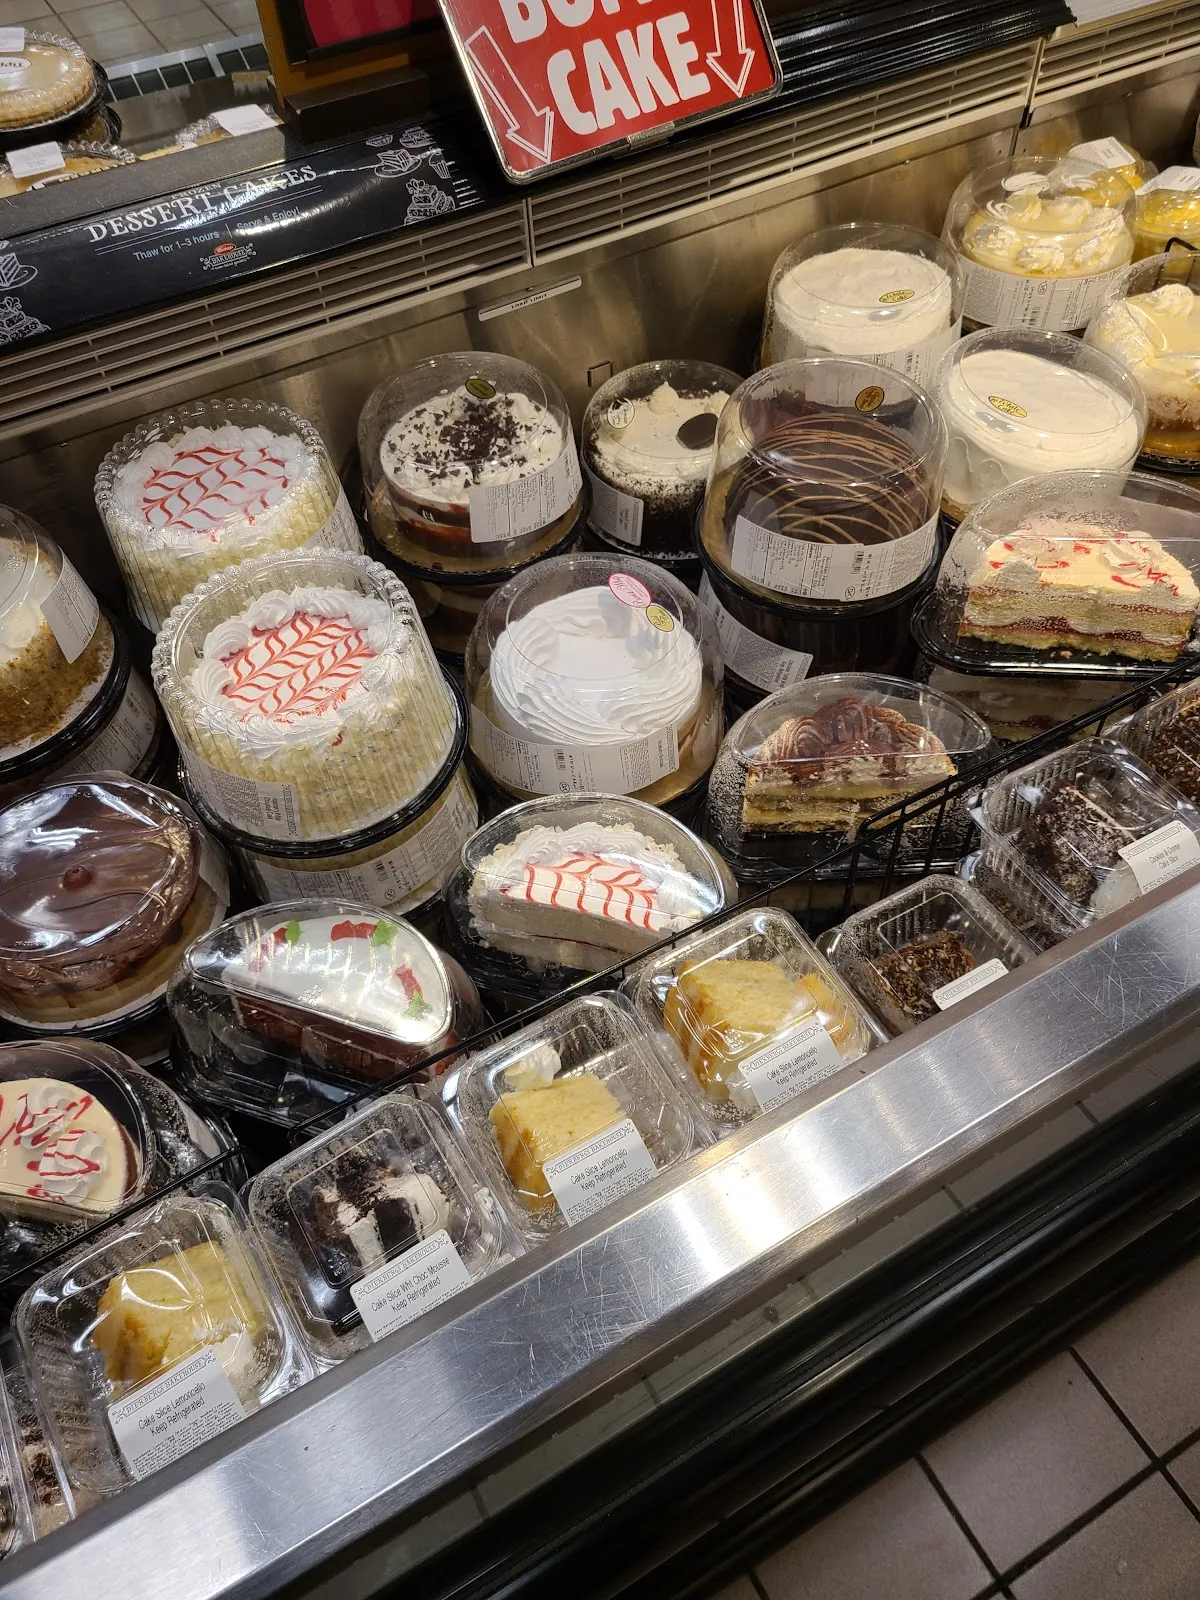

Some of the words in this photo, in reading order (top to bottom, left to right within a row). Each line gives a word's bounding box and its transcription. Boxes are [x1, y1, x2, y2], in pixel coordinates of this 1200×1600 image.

[547, 11, 711, 135] CAKE
[83, 191, 218, 242] DESSERT
[223, 165, 317, 205] CAKES
[171, 183, 221, 199] FROZEN
[264, 216, 271, 224] &
[133, 248, 160, 261] Thaw
[161, 244, 174, 254] for
[193, 231, 219, 244] hours
[511, 301, 528, 309] LOAD
[530, 293, 548, 302] LIMIT
[766, 1070, 780, 1081] Cake
[779, 1062, 792, 1074] Slice
[775, 1075, 790, 1087] Keep
[789, 1058, 818, 1080] Refrigerated
[570, 1173, 585, 1185] Cake
[584, 1165, 599, 1178] Slice
[598, 1147, 628, 1169] Lemoncello
[580, 1178, 596, 1192] Keep
[595, 1160, 628, 1183] Refrigerated
[371, 1297, 387, 1312] Cake
[387, 1287, 401, 1303] Slice
[400, 1279, 414, 1295] Wht
[412, 1271, 429, 1286] Choc
[428, 1257, 451, 1277] Mousse
[391, 1299, 408, 1314] Keep
[407, 1276, 441, 1304] Refrigerated
[125, 1384, 164, 1413] DIERBERGS
[164, 1360, 203, 1389] BAKEHOUSE
[138, 1413, 156, 1430] Cake
[156, 1403, 172, 1419] Slice
[172, 1381, 206, 1409] Lemoncello
[150, 1420, 168, 1437] Keep
[168, 1395, 205, 1427] Refrigerated
